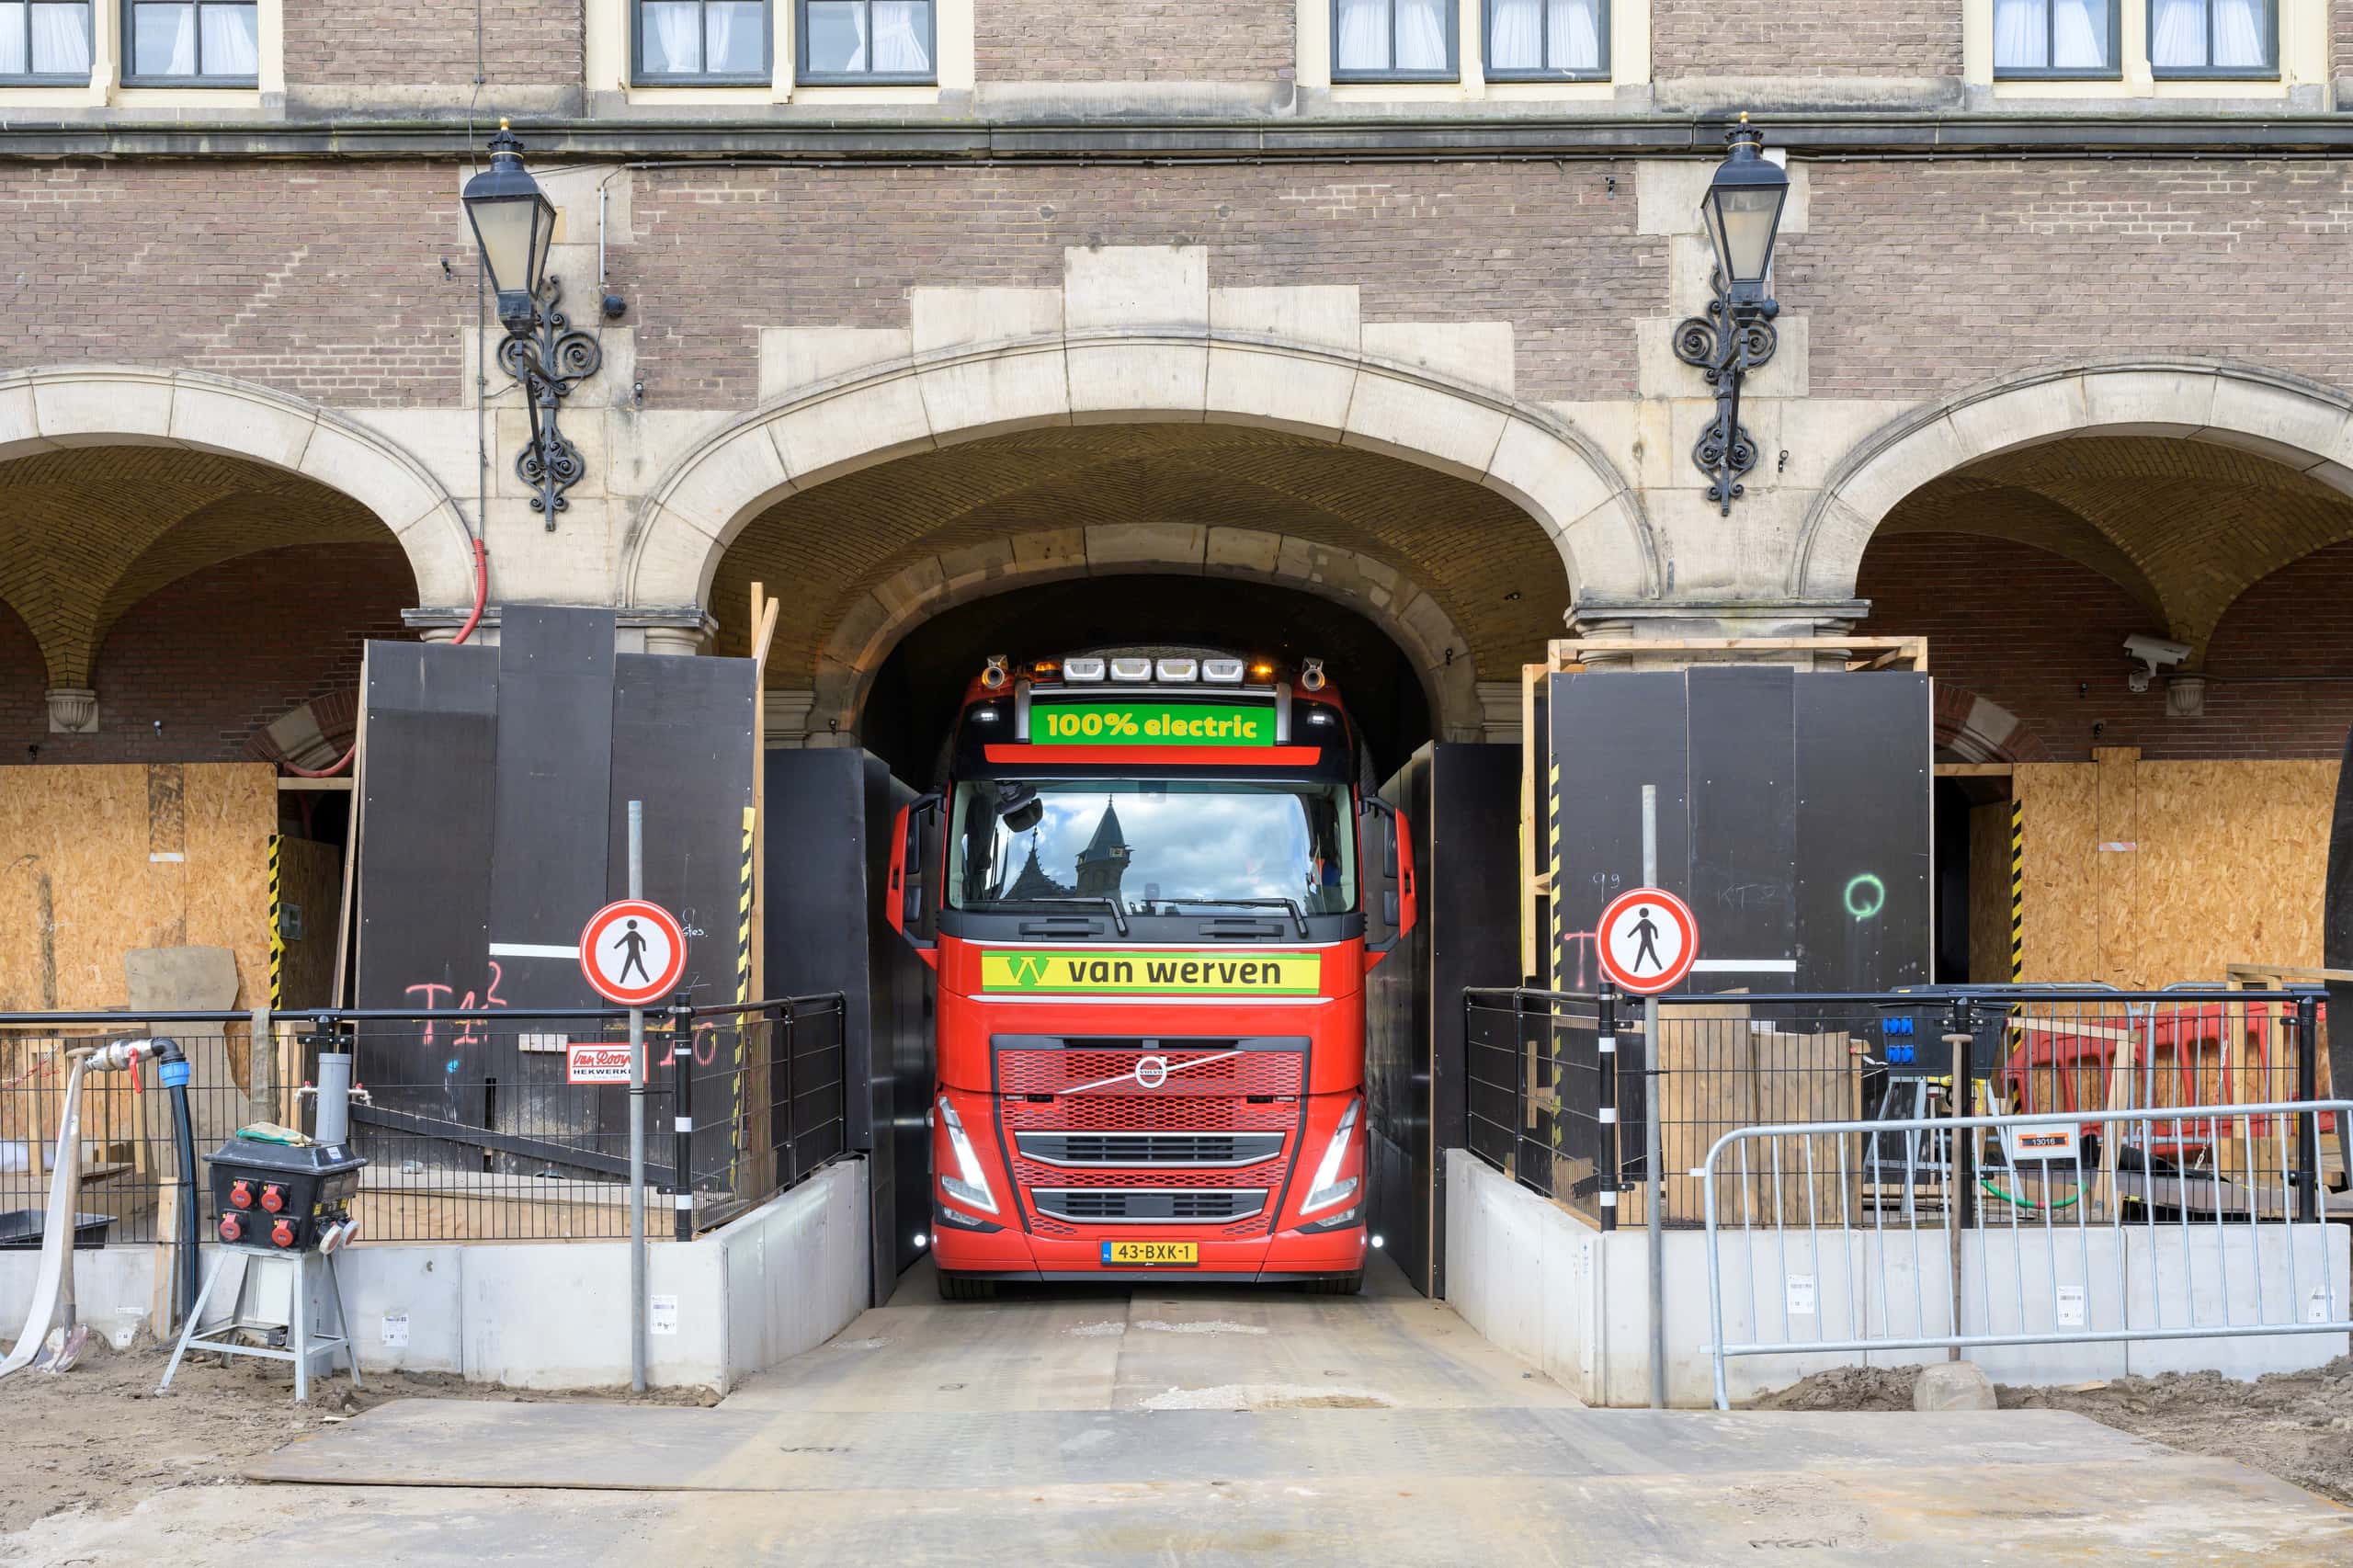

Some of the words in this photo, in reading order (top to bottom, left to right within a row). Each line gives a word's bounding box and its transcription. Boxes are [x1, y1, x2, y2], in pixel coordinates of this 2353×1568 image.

[1047, 712, 1139, 736] 100%
[1144, 714, 1257, 738] electric
[1068, 960, 1133, 983] van
[1146, 961, 1281, 984] werven
[2031, 1138, 2056, 1146] 13016
[1118, 1244, 1189, 1260] 43-BXK-1
